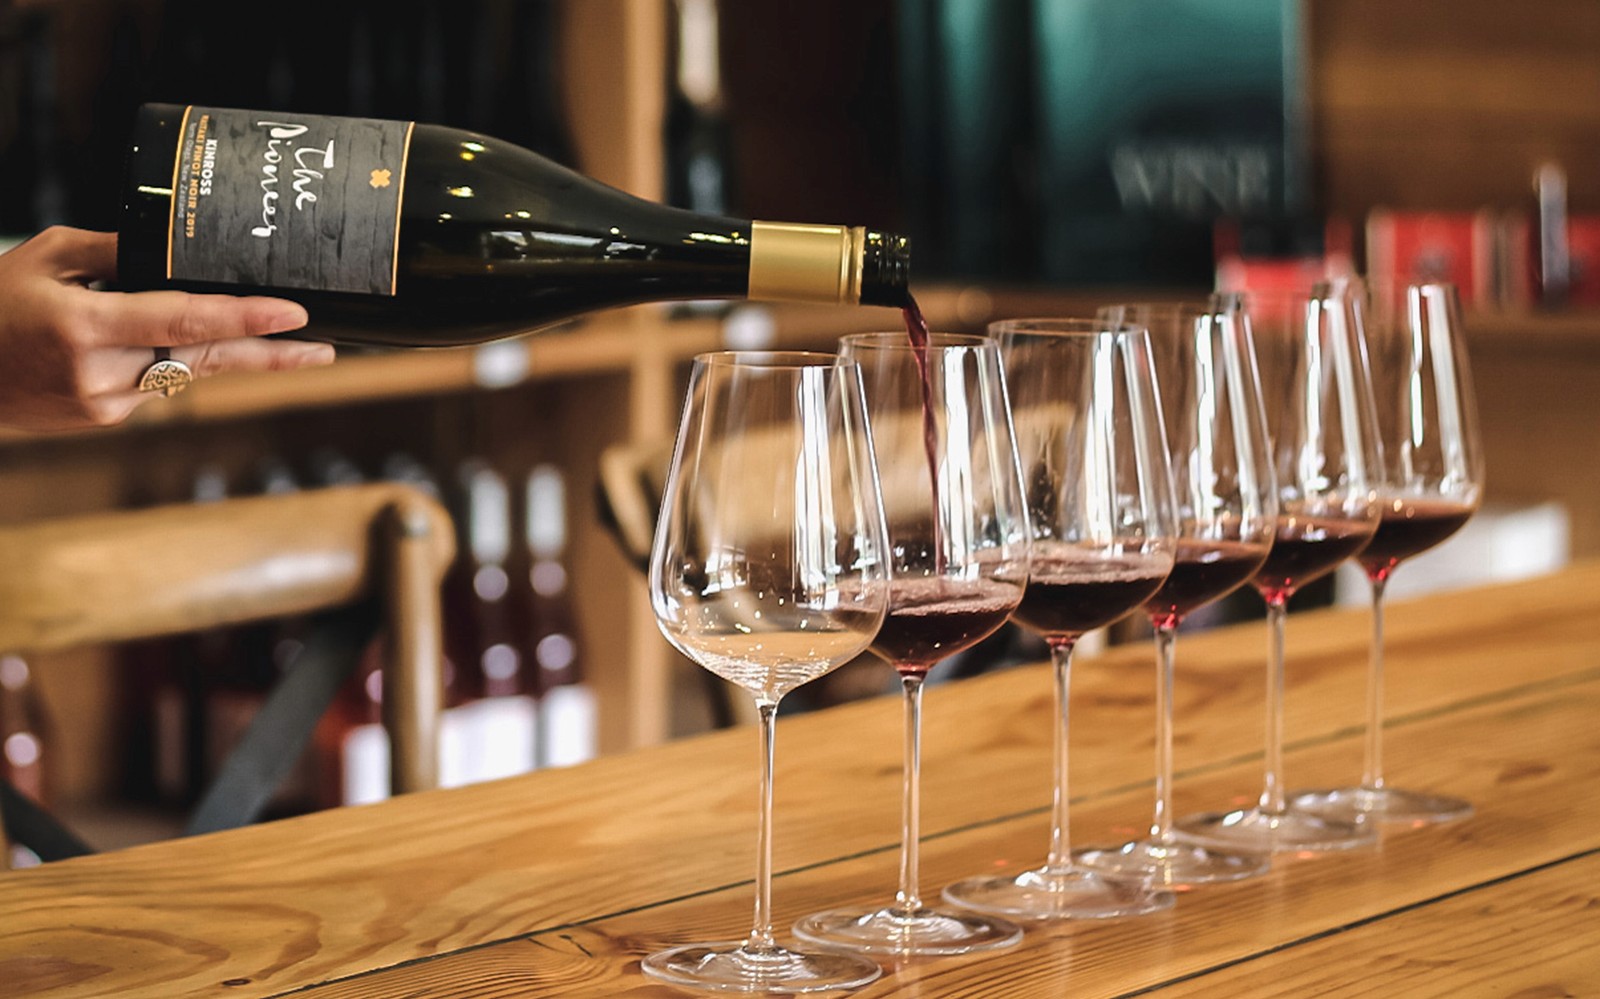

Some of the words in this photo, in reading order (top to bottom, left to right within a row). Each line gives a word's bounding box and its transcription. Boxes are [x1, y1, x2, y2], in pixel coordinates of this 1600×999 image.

[191, 145, 204, 176] PINOT
[200, 139, 218, 195] KINROSS
[251, 121, 309, 237] Pioneer
[292, 140, 334, 211] The
[1111, 146, 1269, 208] WINE
[188, 179, 199, 209] NOIR
[186, 212, 196, 238] 2019
